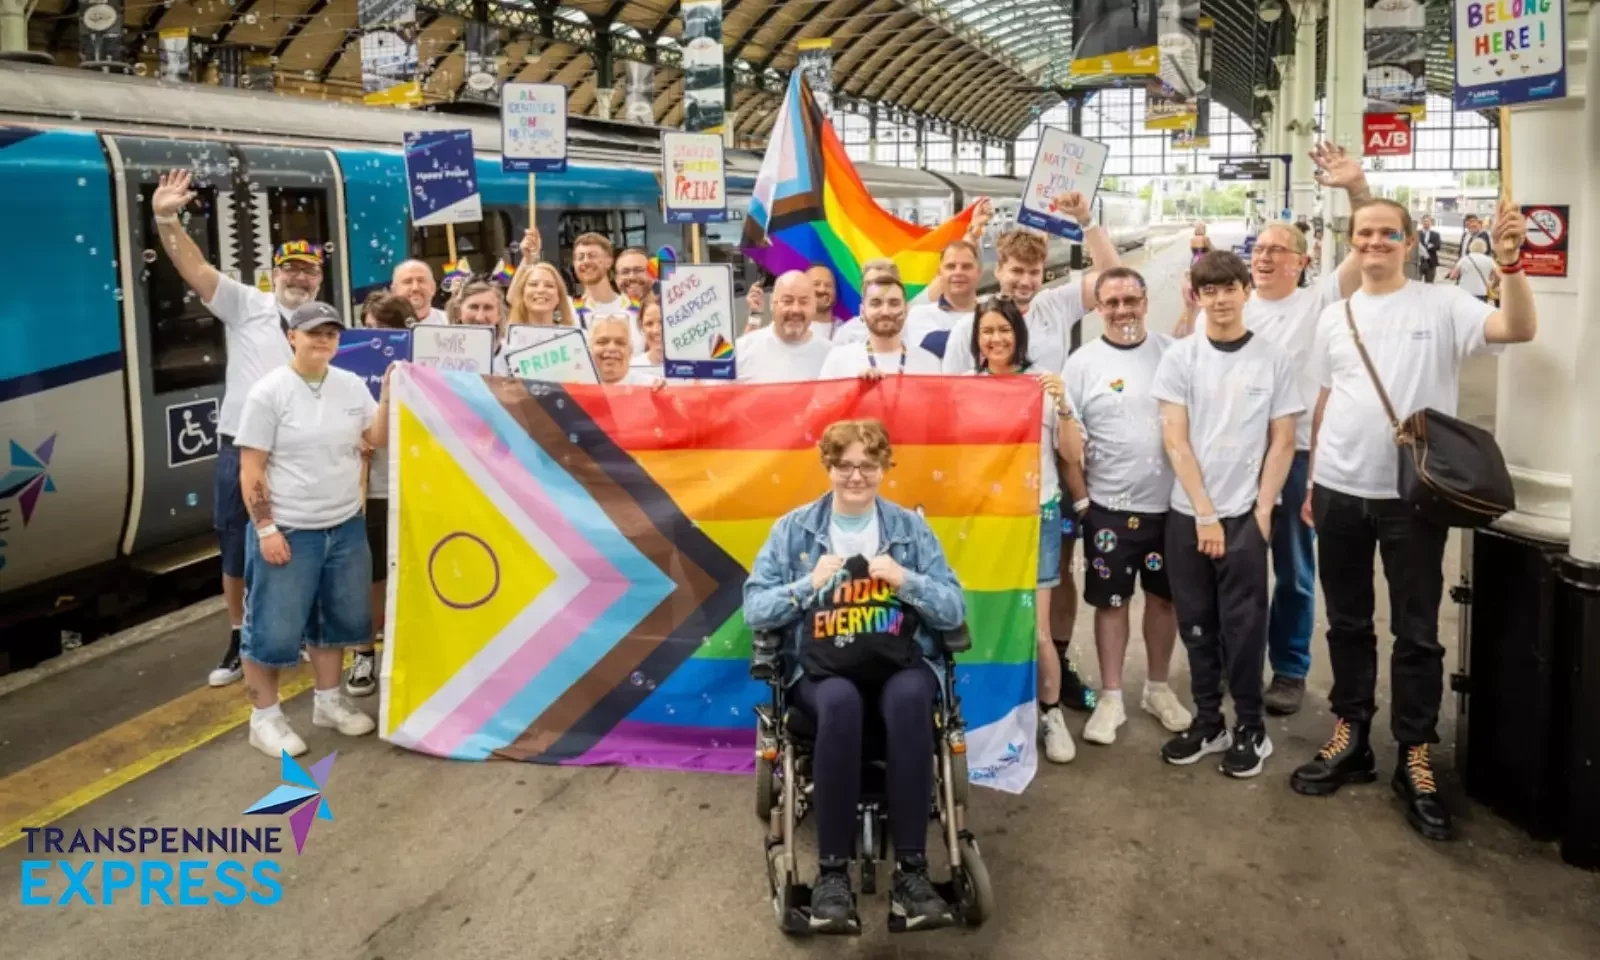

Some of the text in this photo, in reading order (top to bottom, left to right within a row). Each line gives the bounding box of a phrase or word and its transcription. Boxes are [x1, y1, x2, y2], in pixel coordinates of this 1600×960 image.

[1467, 0, 1551, 28] BELONG
[1475, 26, 1530, 57] HERE
[1368, 131, 1408, 148] A/B
[674, 175, 718, 201] PRIDE
[667, 274, 701, 304] LOVE
[434, 331, 467, 354] WE
[671, 312, 722, 351] REPEAT
[520, 345, 570, 376] PRIDE
